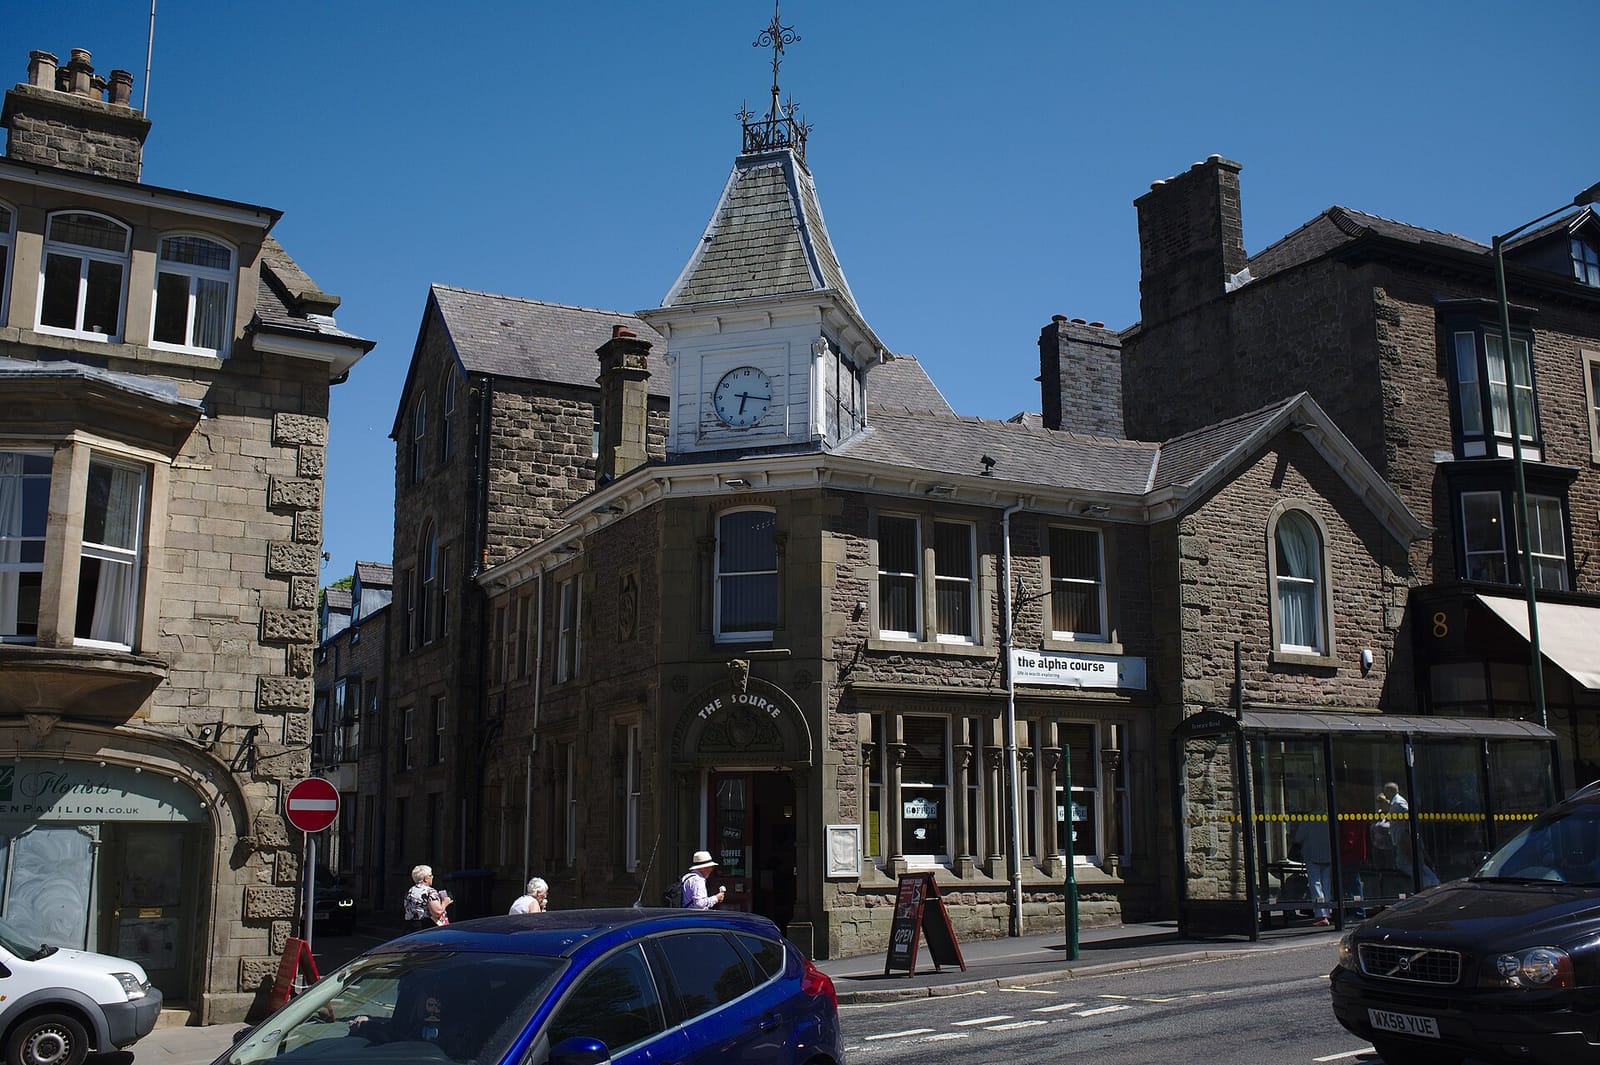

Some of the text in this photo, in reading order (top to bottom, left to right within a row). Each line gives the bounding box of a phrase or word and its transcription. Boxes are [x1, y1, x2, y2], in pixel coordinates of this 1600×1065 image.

[1432, 610, 1449, 638] 8
[1018, 656, 1105, 672] the alpha course
[698, 694, 782, 720] THE SOURCE
[20, 770, 112, 798] Florists
[895, 929, 914, 943] OPEN
[1407, 1016, 1434, 1034] YUE
